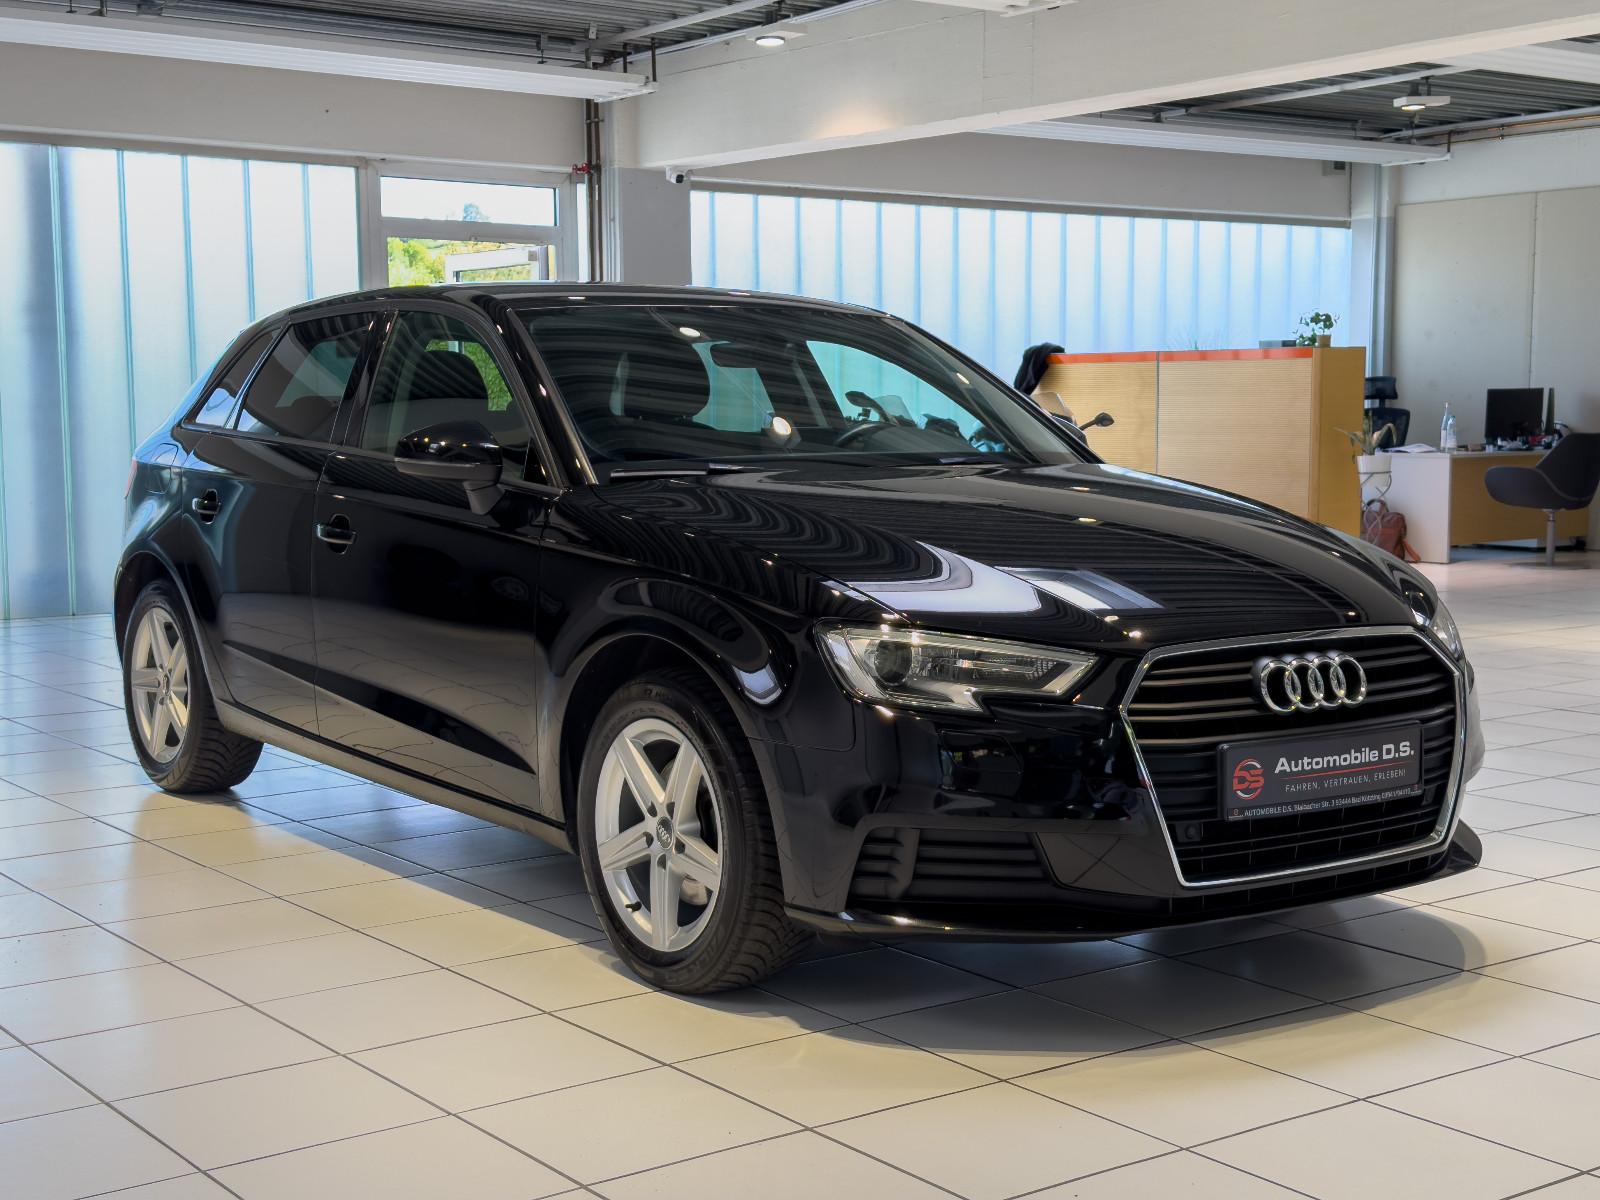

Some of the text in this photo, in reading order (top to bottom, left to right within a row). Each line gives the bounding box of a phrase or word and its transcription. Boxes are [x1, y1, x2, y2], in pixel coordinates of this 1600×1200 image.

[1274, 741, 1415, 774] Automobile D.S.
[1285, 769, 1406, 793] FAHREN, VERTRAUEN, ERLEBEN!
[1244, 806, 1281, 817] AUTOMOBILE
